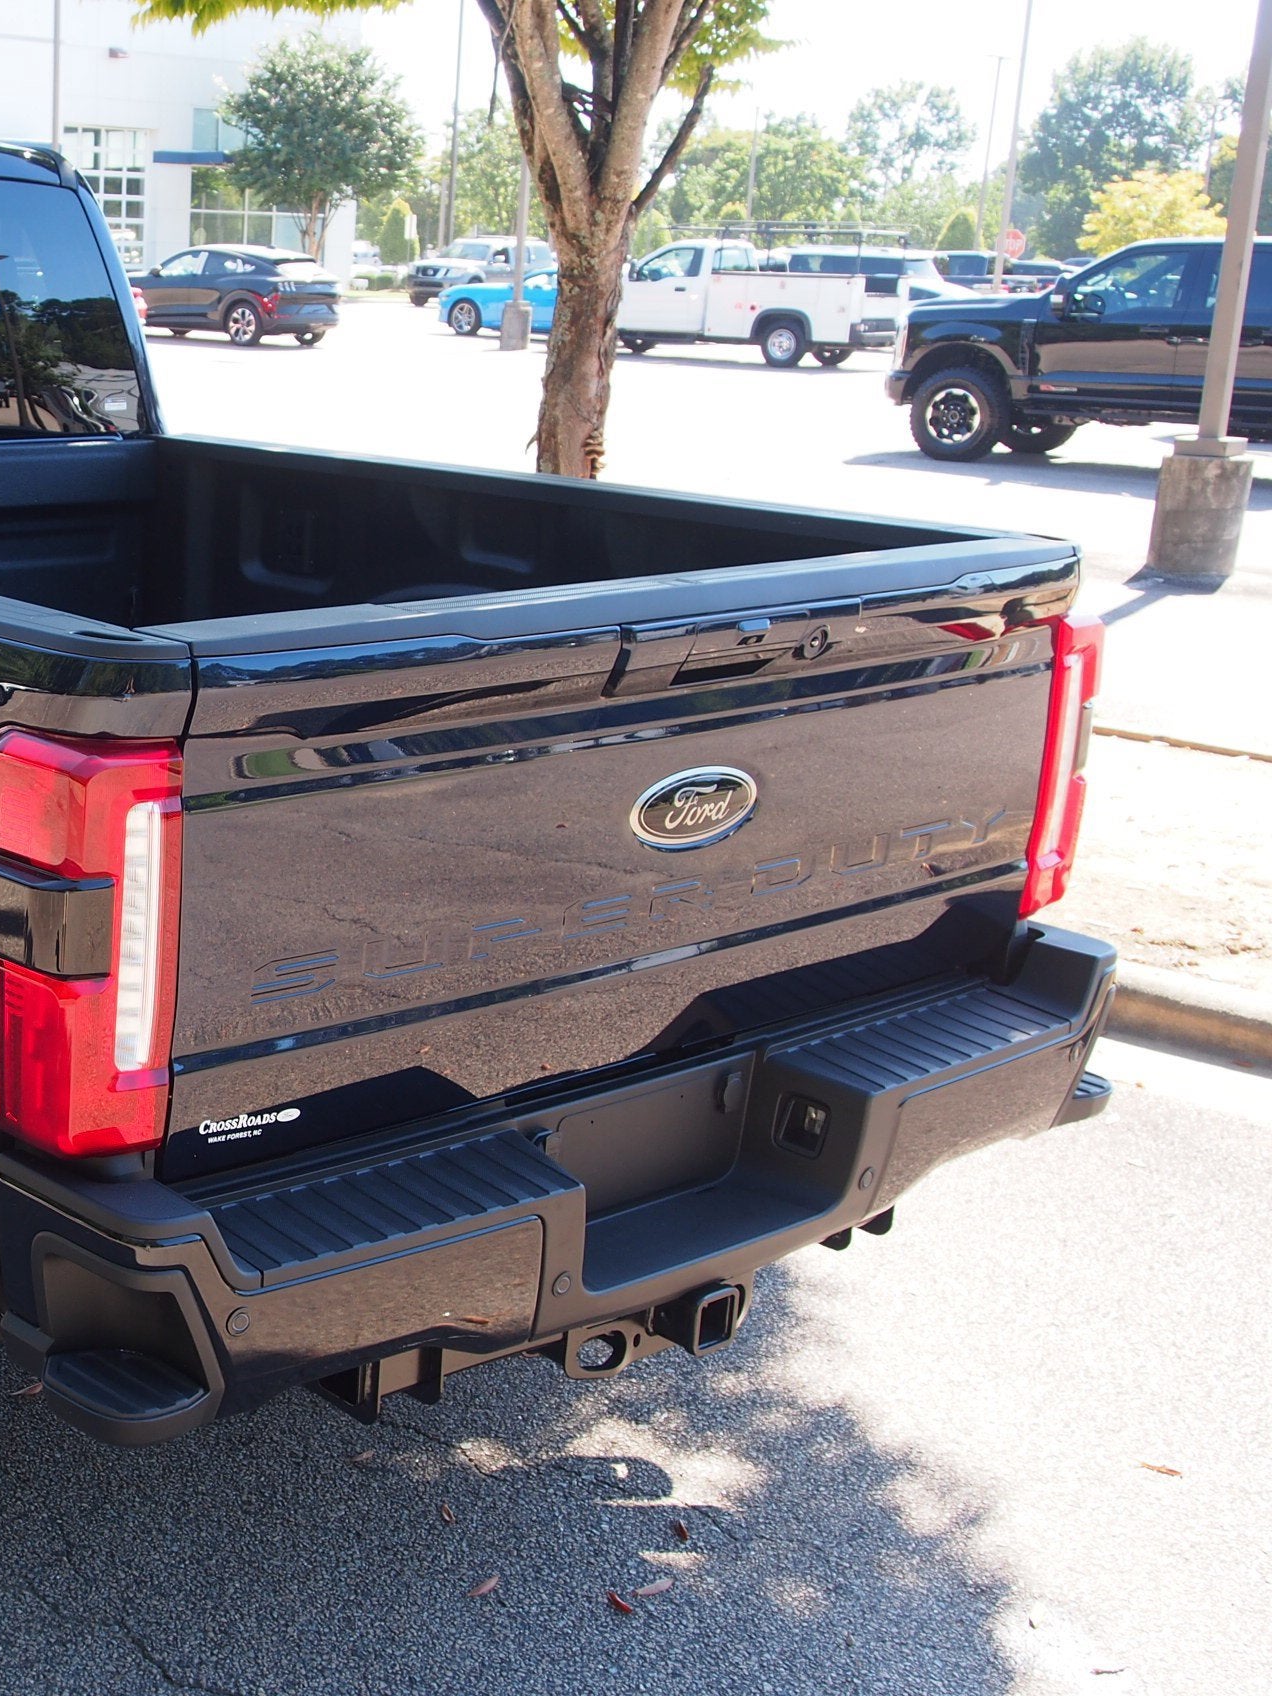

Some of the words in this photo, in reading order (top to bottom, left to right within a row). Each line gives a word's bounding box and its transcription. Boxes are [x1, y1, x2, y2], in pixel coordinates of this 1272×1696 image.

[664, 783, 734, 830] Ford
[250, 874, 716, 1005] SUPER
[750, 805, 1009, 897] DUTY
[207, 1134, 227, 1144] WAKE
[226, 1130, 253, 1141] FOREST,
[252, 1128, 263, 1137] NC
